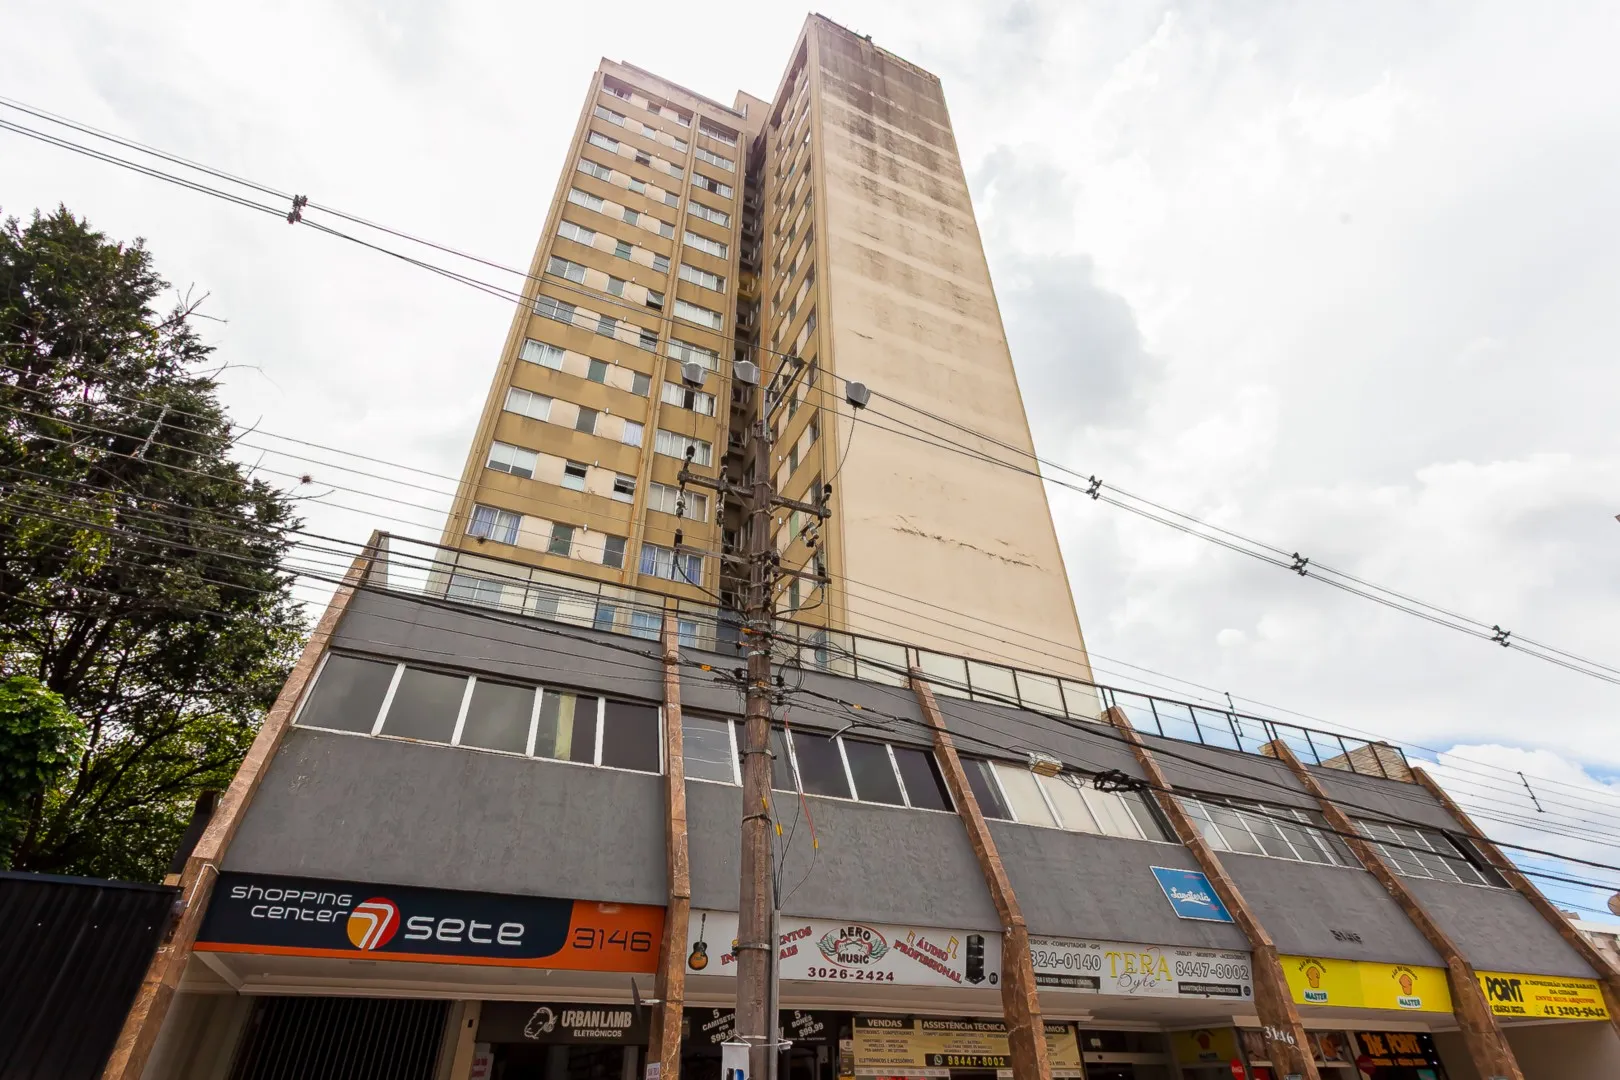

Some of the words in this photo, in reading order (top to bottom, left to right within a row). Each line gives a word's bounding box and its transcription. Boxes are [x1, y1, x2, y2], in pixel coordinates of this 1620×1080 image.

[572, 927, 653, 952] 3146
[839, 926, 871, 943] AERO
[837, 952, 870, 965] MUSIC
[892, 939, 963, 985] PROFISSIONAL
[1029, 949, 1102, 972] 324-0140
[1103, 950, 1174, 982] TERA
[807, 966, 895, 982] 3026-2424
[1175, 960, 1250, 981] 8447-8002
[712, 1008, 720, 1019] 5
[794, 1010, 801, 1020] 5
[867, 1018, 903, 1028] VENDAS
[1263, 1026, 1296, 1046] 3146
[947, 1055, 1005, 1067] 98447-8002
